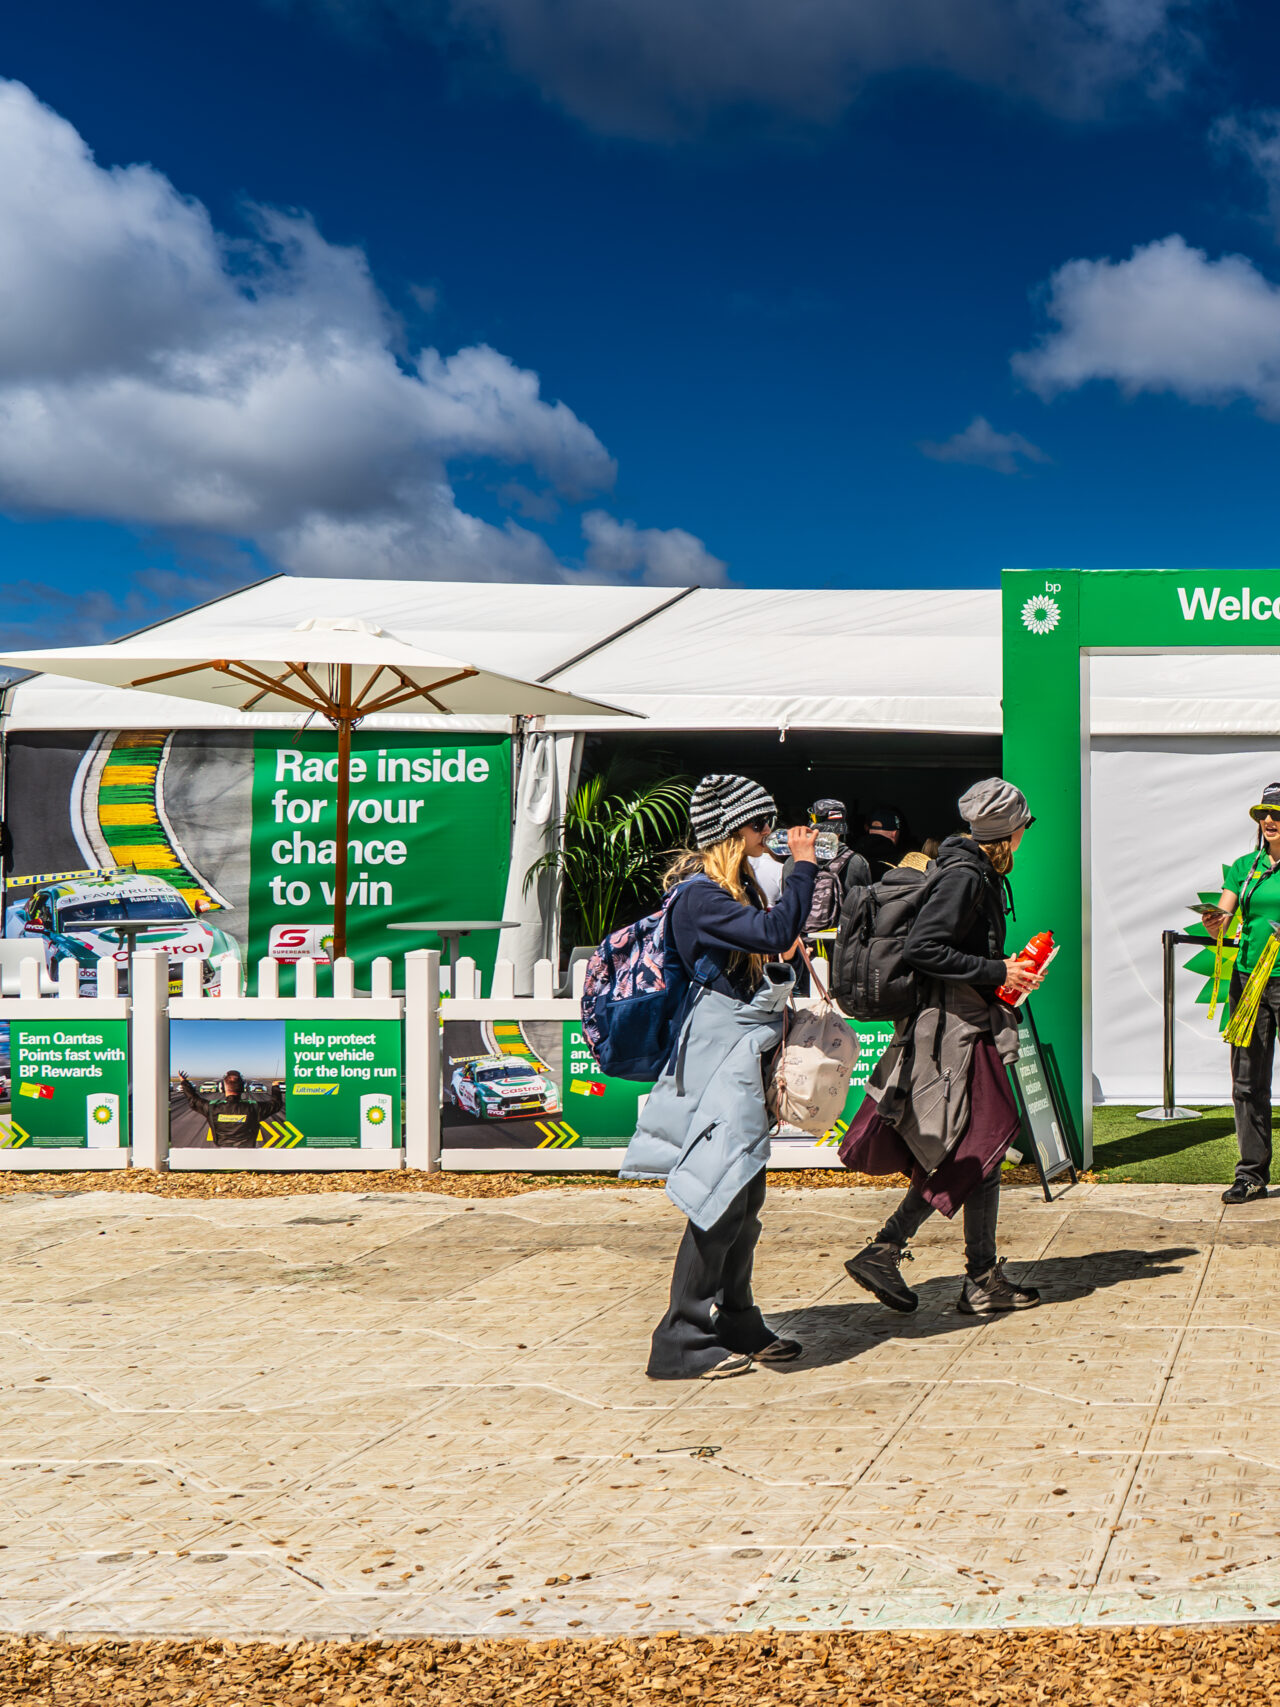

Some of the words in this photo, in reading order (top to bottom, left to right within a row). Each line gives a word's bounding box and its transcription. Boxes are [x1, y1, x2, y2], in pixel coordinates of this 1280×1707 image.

[1045, 580, 1062, 595] bp
[274, 749, 368, 782] Race
[377, 749, 490, 783] inside
[271, 789, 328, 823] for
[271, 831, 408, 865] chance
[268, 874, 312, 906] to
[319, 872, 393, 906] win
[112, 943, 205, 962] Ctrol
[19, 1031, 51, 1045] Earn
[53, 1031, 104, 1046] Qantas
[294, 1032, 326, 1047] Help
[327, 1032, 377, 1048] protect
[19, 1048, 63, 1062] Points
[64, 1048, 92, 1062] fast
[93, 1047, 126, 1061] with
[294, 1050, 326, 1064] your
[327, 1048, 375, 1062] vehicle
[19, 1064, 39, 1078] BP
[41, 1064, 104, 1078] Rewards
[294, 1064, 314, 1078] for
[316, 1064, 339, 1078] the
[340, 1064, 372, 1080] long
[373, 1066, 398, 1078] run
[570, 1062, 589, 1075] BP
[501, 1086, 542, 1096] Castrol
